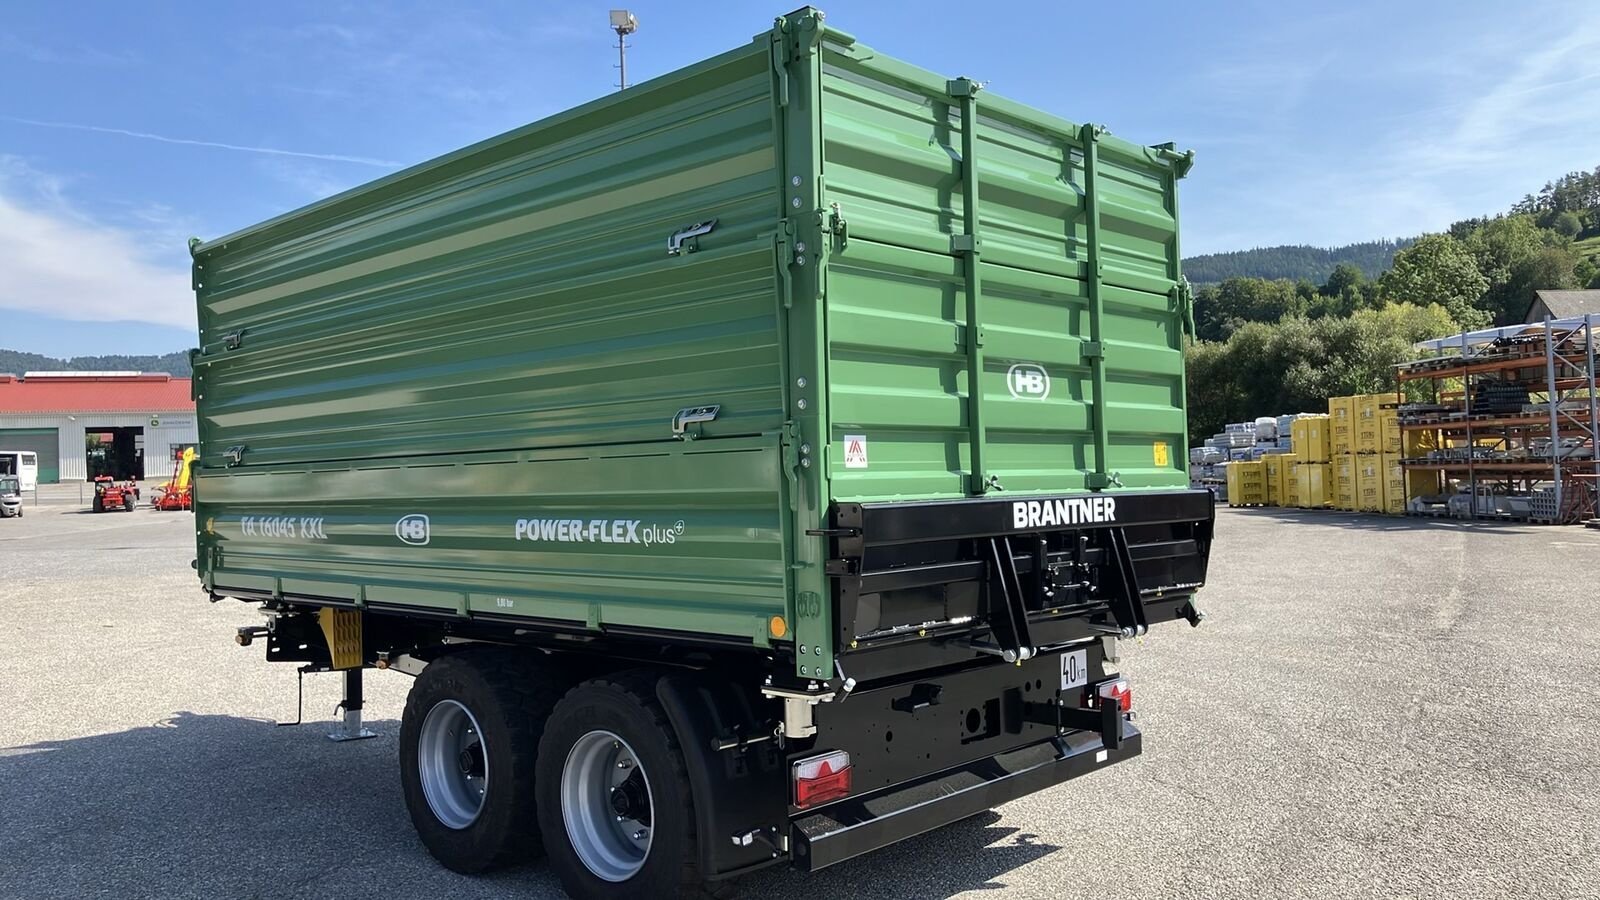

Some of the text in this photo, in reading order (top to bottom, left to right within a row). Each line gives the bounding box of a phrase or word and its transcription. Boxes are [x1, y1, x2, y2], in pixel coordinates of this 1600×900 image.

[1013, 497, 1116, 529] BRANTNER
[259, 517, 296, 538] 16045
[301, 517, 328, 539] XXL
[515, 519, 641, 544] POWER-FLEX
[1063, 655, 1076, 685] 40
